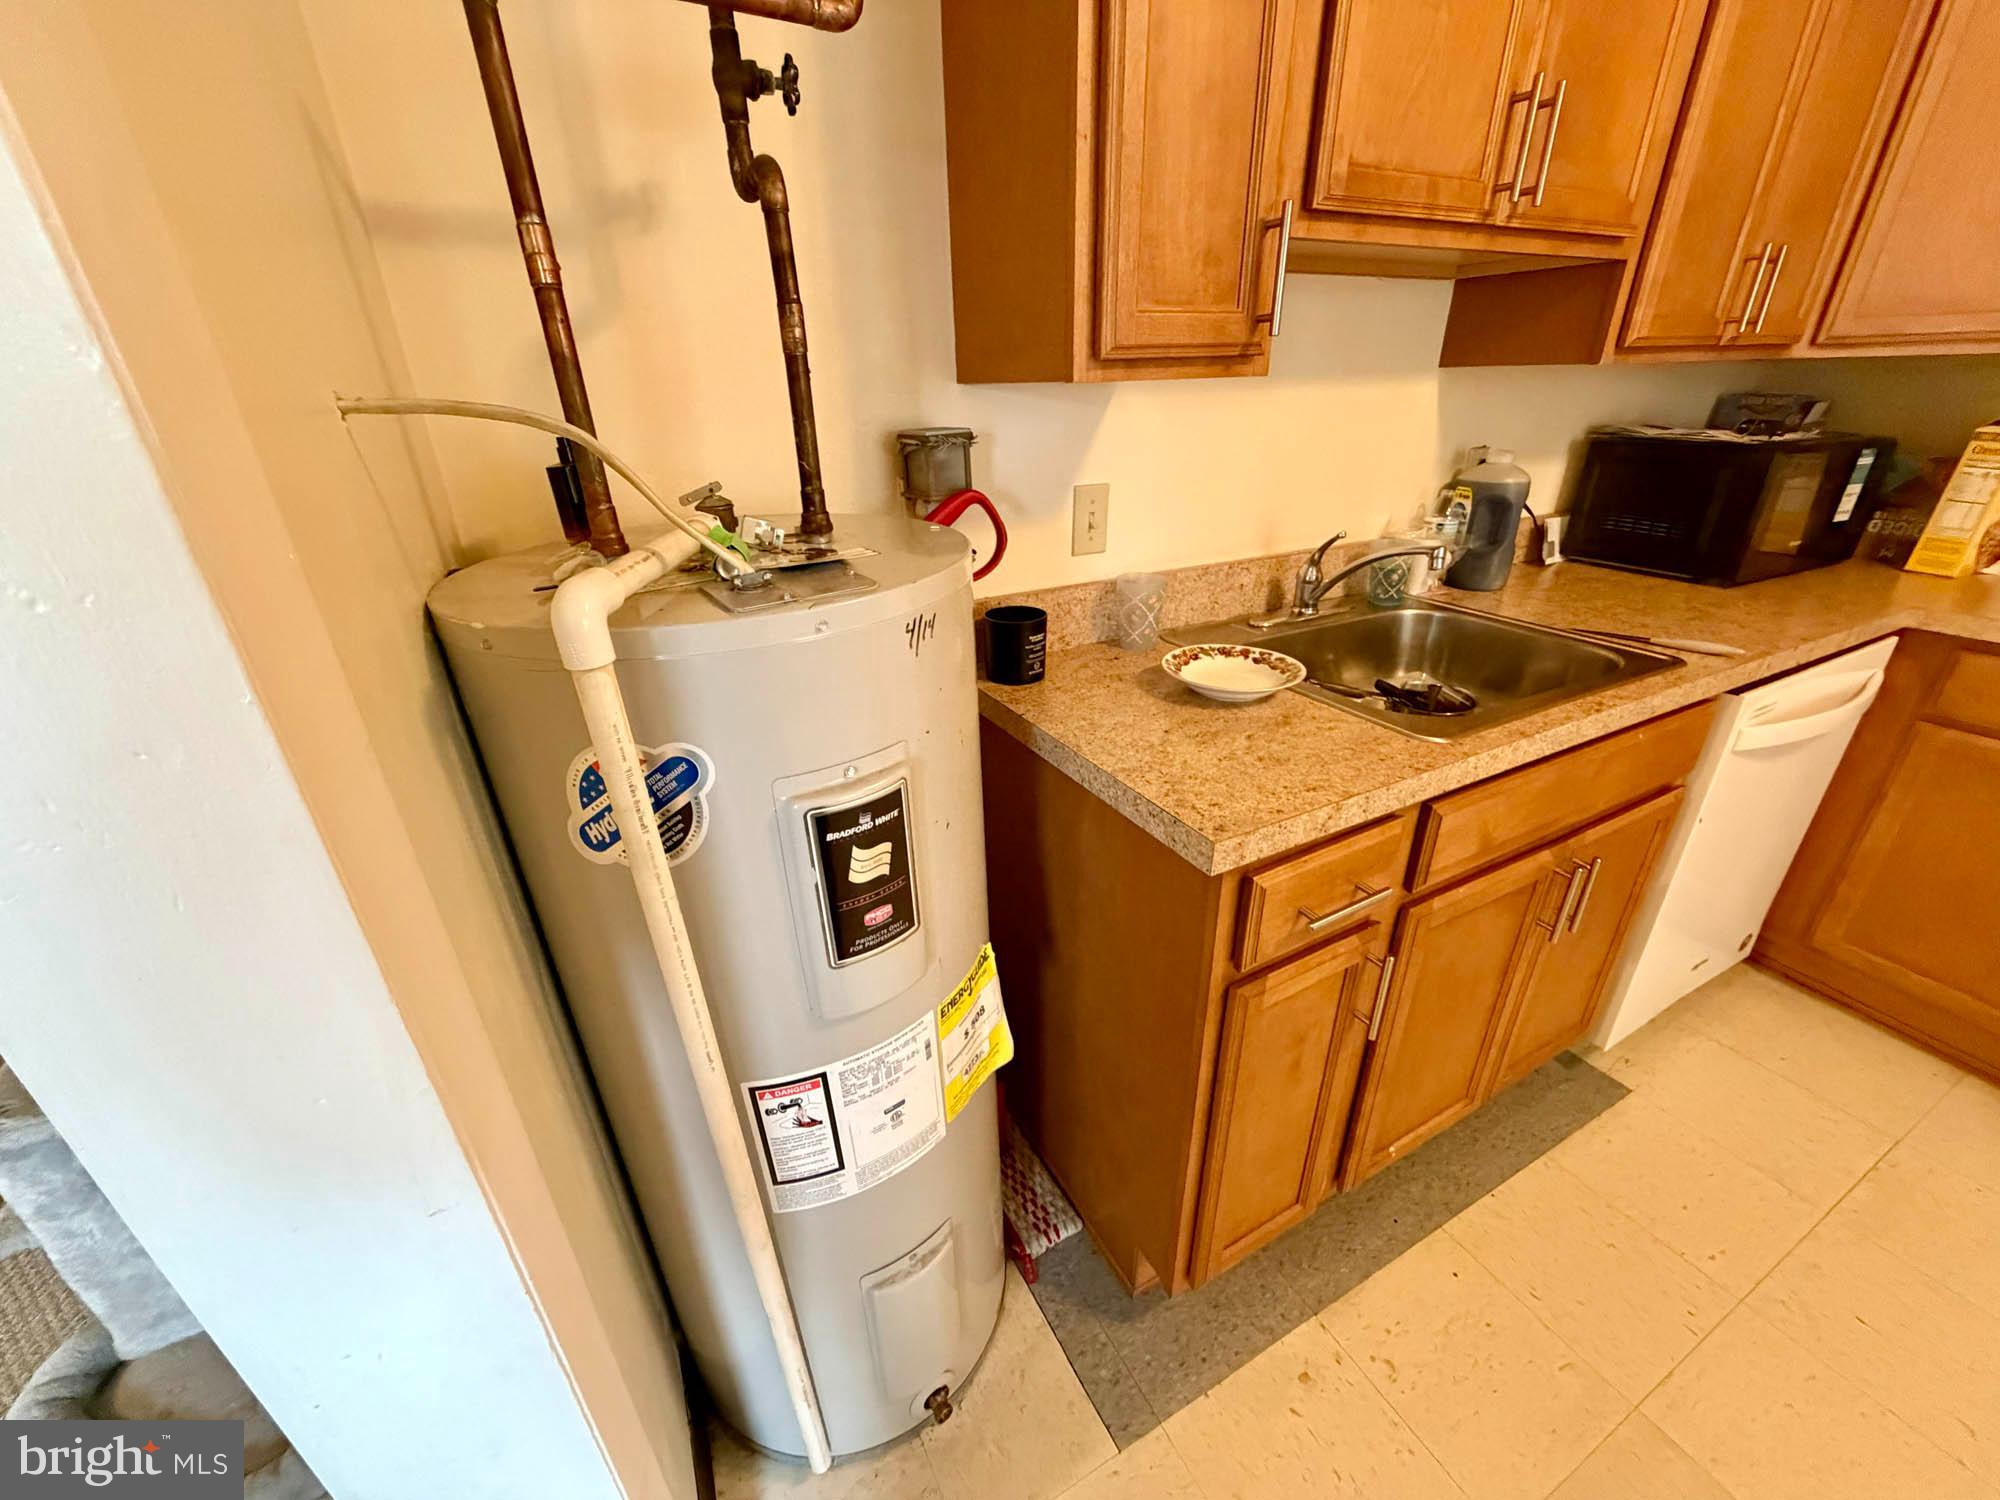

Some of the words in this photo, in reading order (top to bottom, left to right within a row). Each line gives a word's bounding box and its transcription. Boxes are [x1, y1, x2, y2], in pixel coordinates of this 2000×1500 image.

[905, 612, 937, 657] 4/14
[647, 771, 663, 786] TOTAL
[652, 761, 688, 793] PERFORMANCE
[656, 780, 678, 799] SYSTEM
[585, 811, 618, 845] Hyd
[825, 821, 874, 842] BRADFORD
[875, 808, 900, 826] WHITE
[849, 944, 864, 953] FOR
[774, 1082, 813, 1098] DANGER
